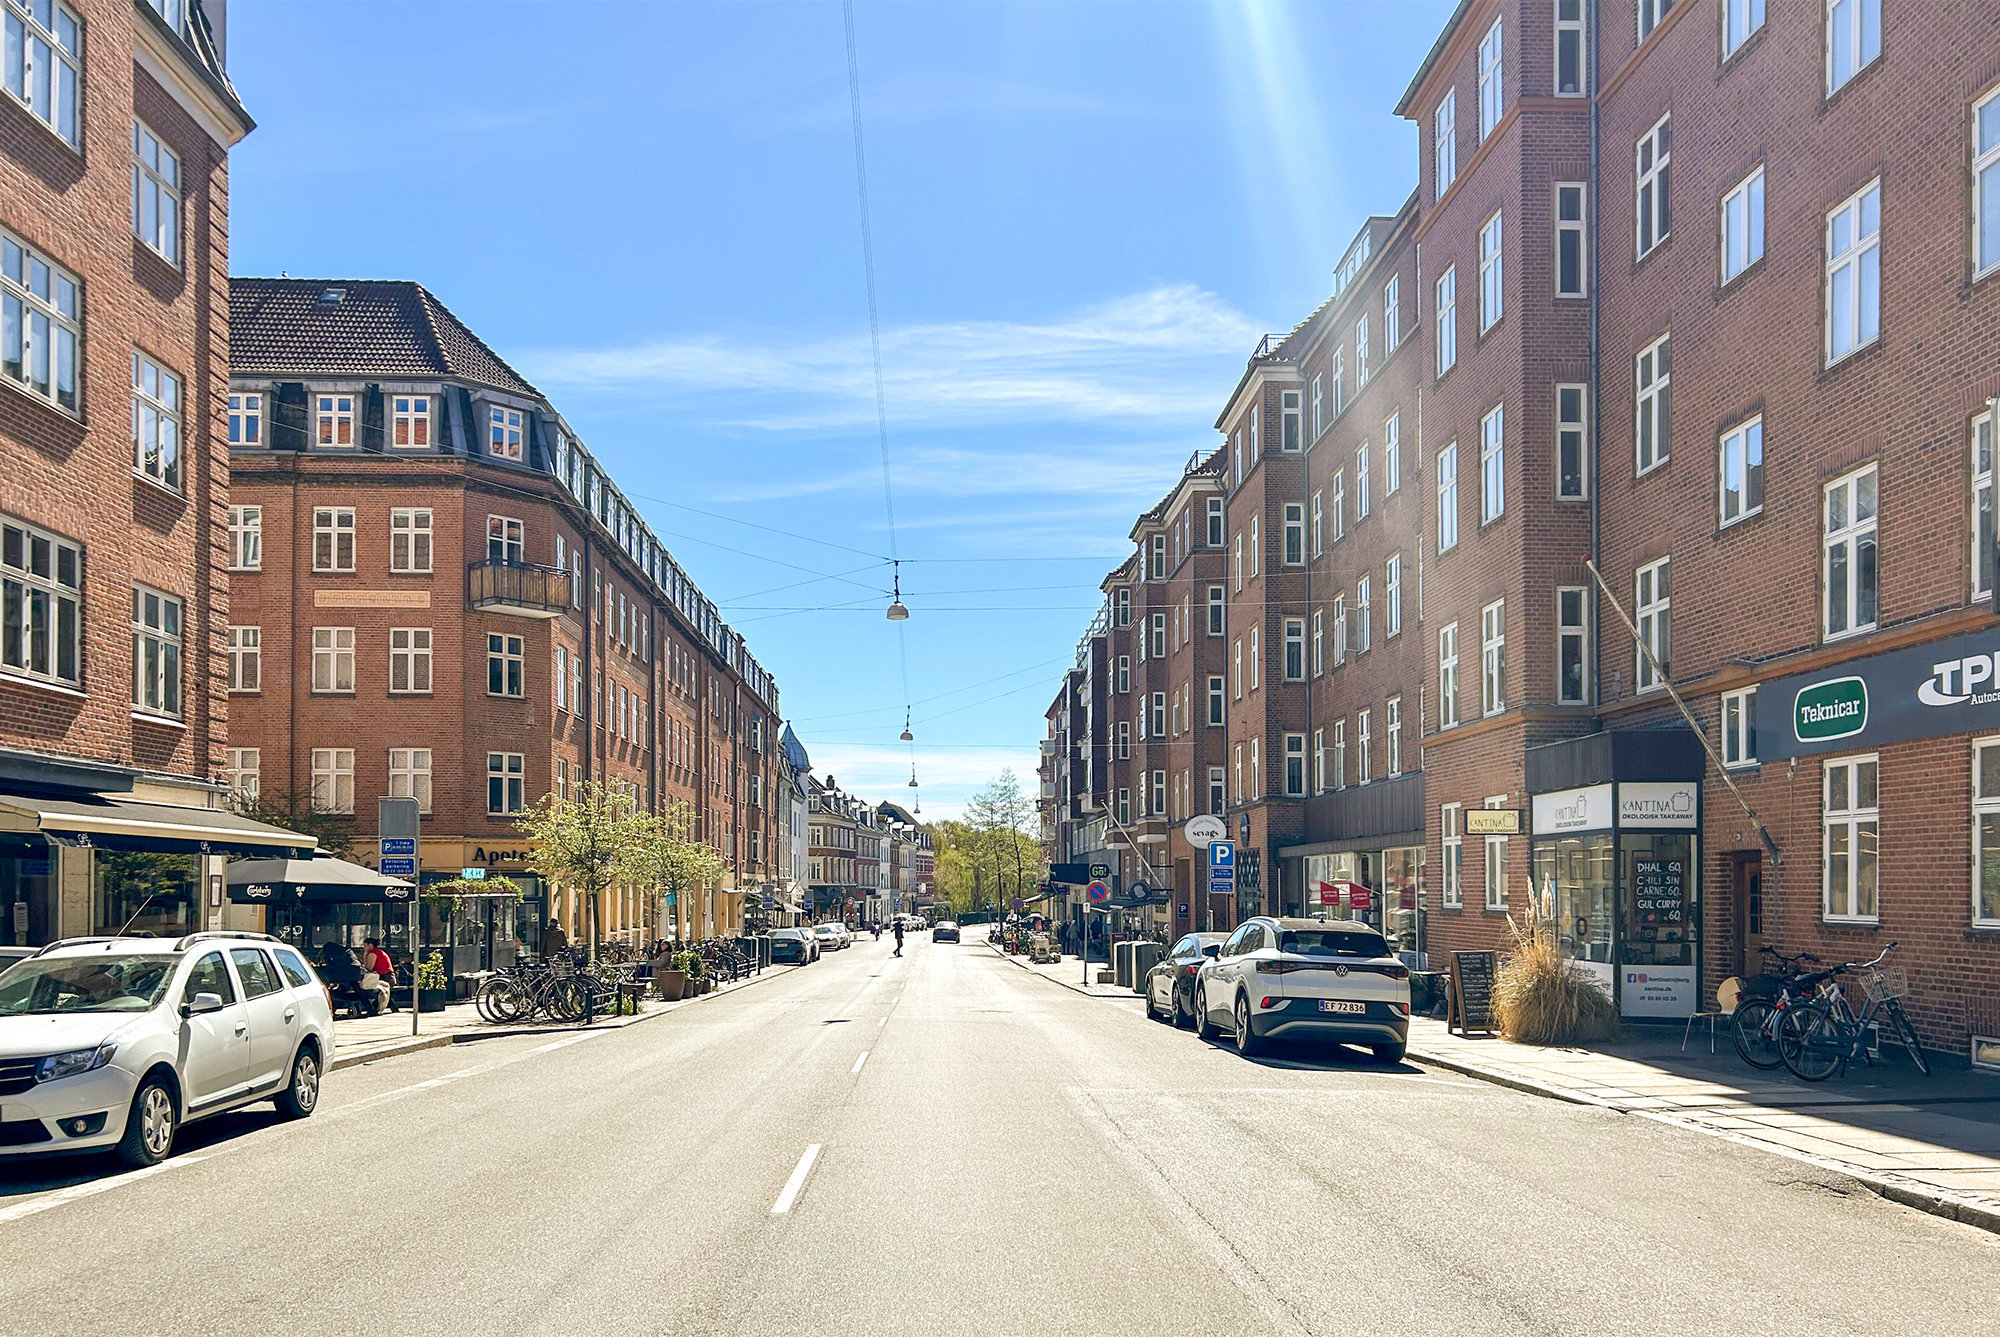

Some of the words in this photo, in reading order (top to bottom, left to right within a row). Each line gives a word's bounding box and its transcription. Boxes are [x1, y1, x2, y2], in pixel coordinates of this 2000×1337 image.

[1933, 650, 2000, 695] TP
[1801, 699, 1860, 724] Teknicar
[1622, 800, 1671, 812] KANTINA
[1469, 818, 1503, 828] KANTINA
[1192, 829, 1219, 838] sevags
[384, 842, 391, 850] P
[1216, 845, 1230, 864] P
[1637, 862, 1662, 873] DHAL
[1636, 876, 1661, 885] CHILI
[1664, 875, 1680, 885] SIN
[247, 885, 271, 898] Carlsberg
[385, 886, 409, 899] Carlsberg
[1637, 899, 1655, 909] GUL
[1656, 899, 1681, 909] CURRY
[1325, 1002, 1336, 1010] EF
